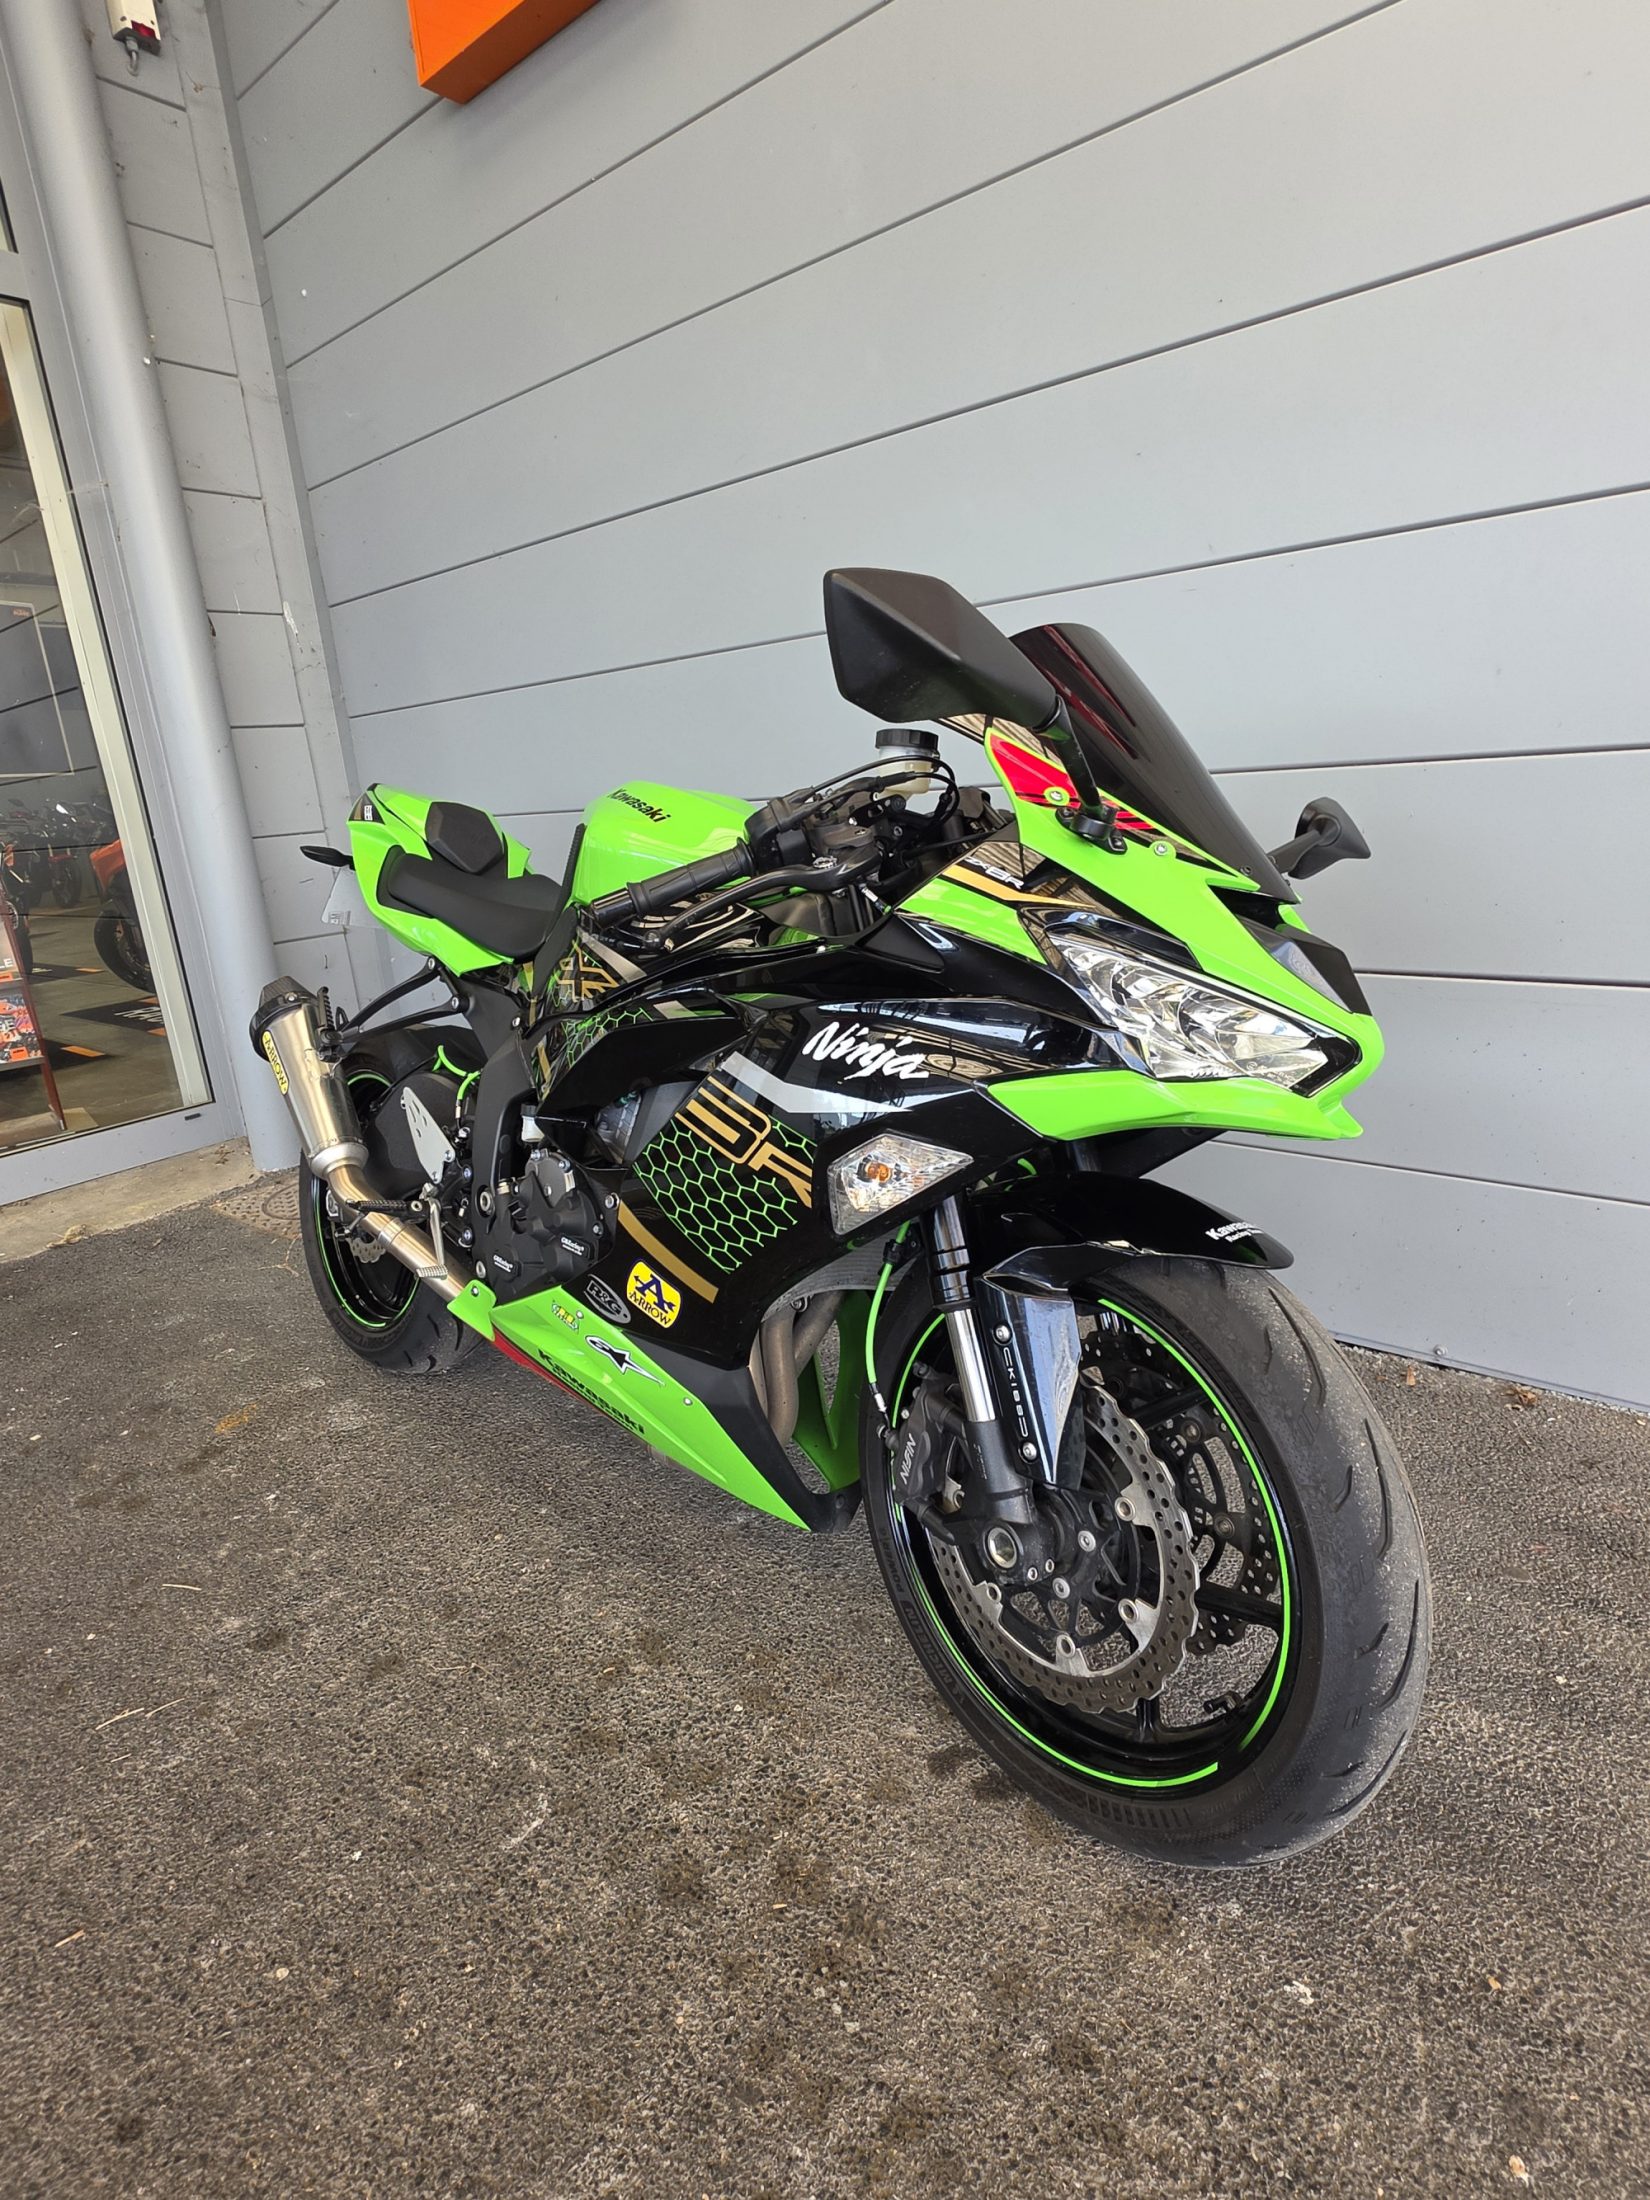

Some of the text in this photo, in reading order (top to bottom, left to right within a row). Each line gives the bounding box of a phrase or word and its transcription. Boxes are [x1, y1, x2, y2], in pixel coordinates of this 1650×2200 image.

[607, 788, 671, 822] Kawasaki
[802, 1021, 929, 1080] Ninja
[587, 1281, 623, 1315] R&G
[629, 1291, 671, 1325] ARROW
